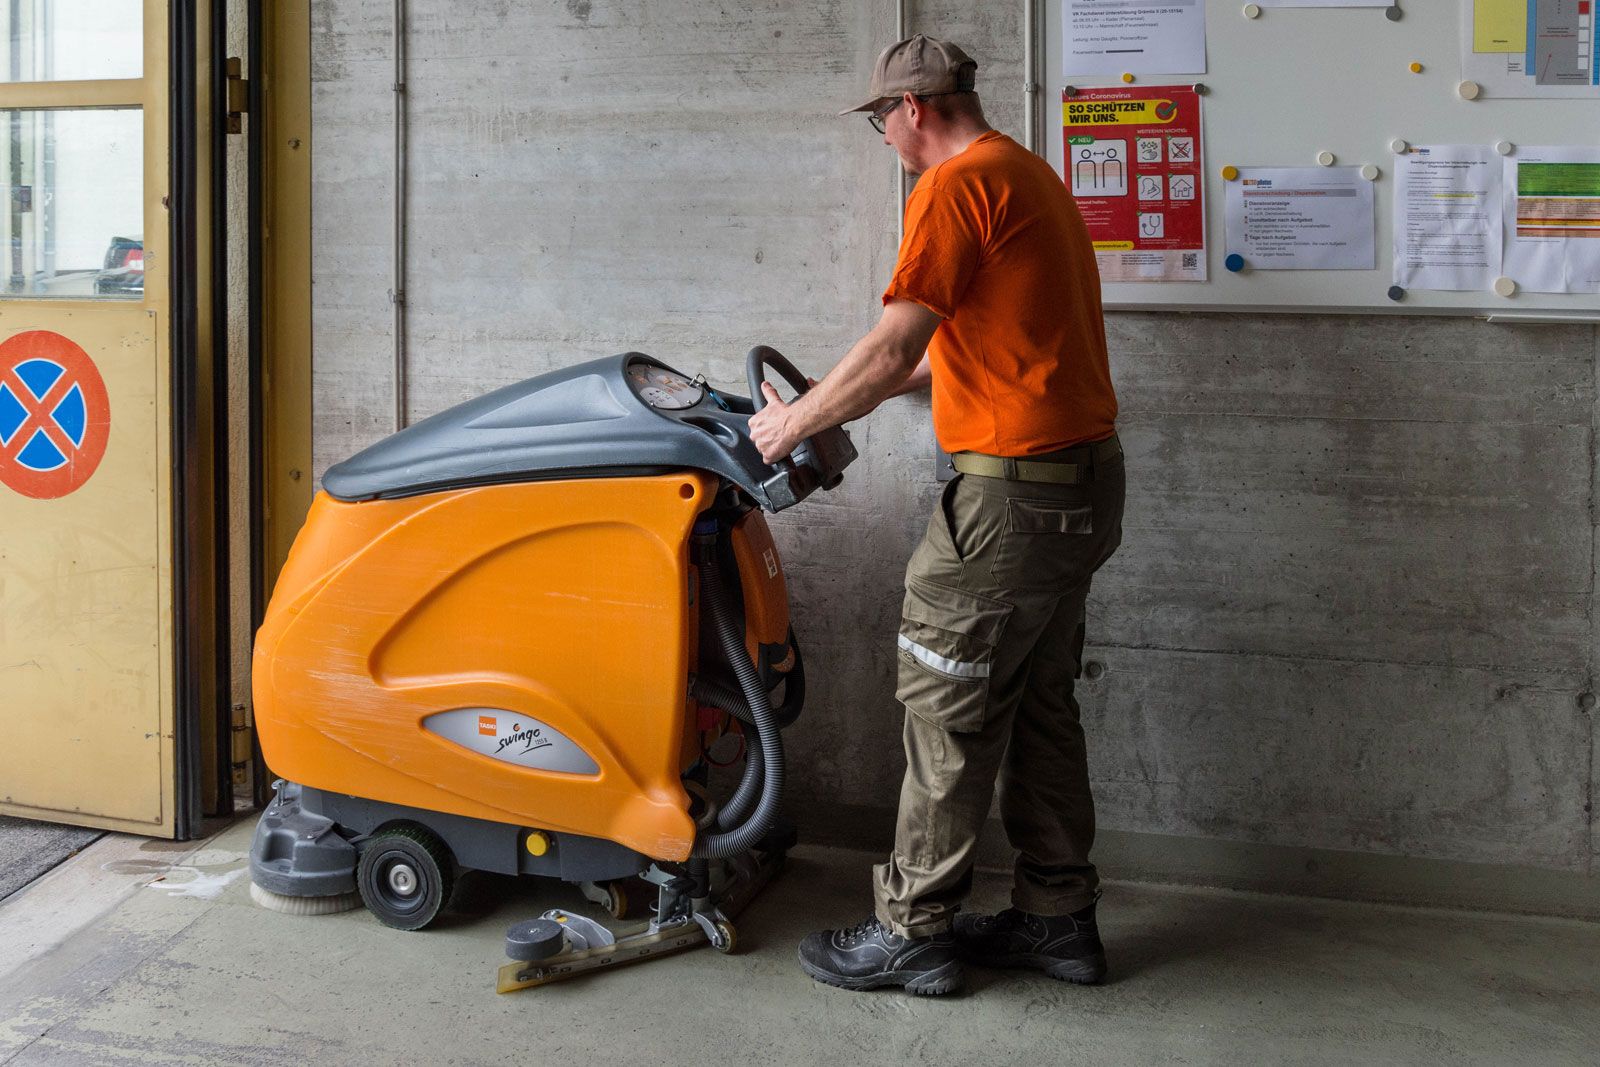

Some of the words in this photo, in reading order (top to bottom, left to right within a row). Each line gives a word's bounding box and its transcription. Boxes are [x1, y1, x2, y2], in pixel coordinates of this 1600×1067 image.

[1069, 104, 1084, 113] SO
[1086, 101, 1145, 113] SCHÜTZEN
[1069, 114, 1090, 123] WIR
[1092, 113, 1119, 123] UNS.
[480, 722, 497, 730] TASKI
[495, 724, 541, 754] swingo
